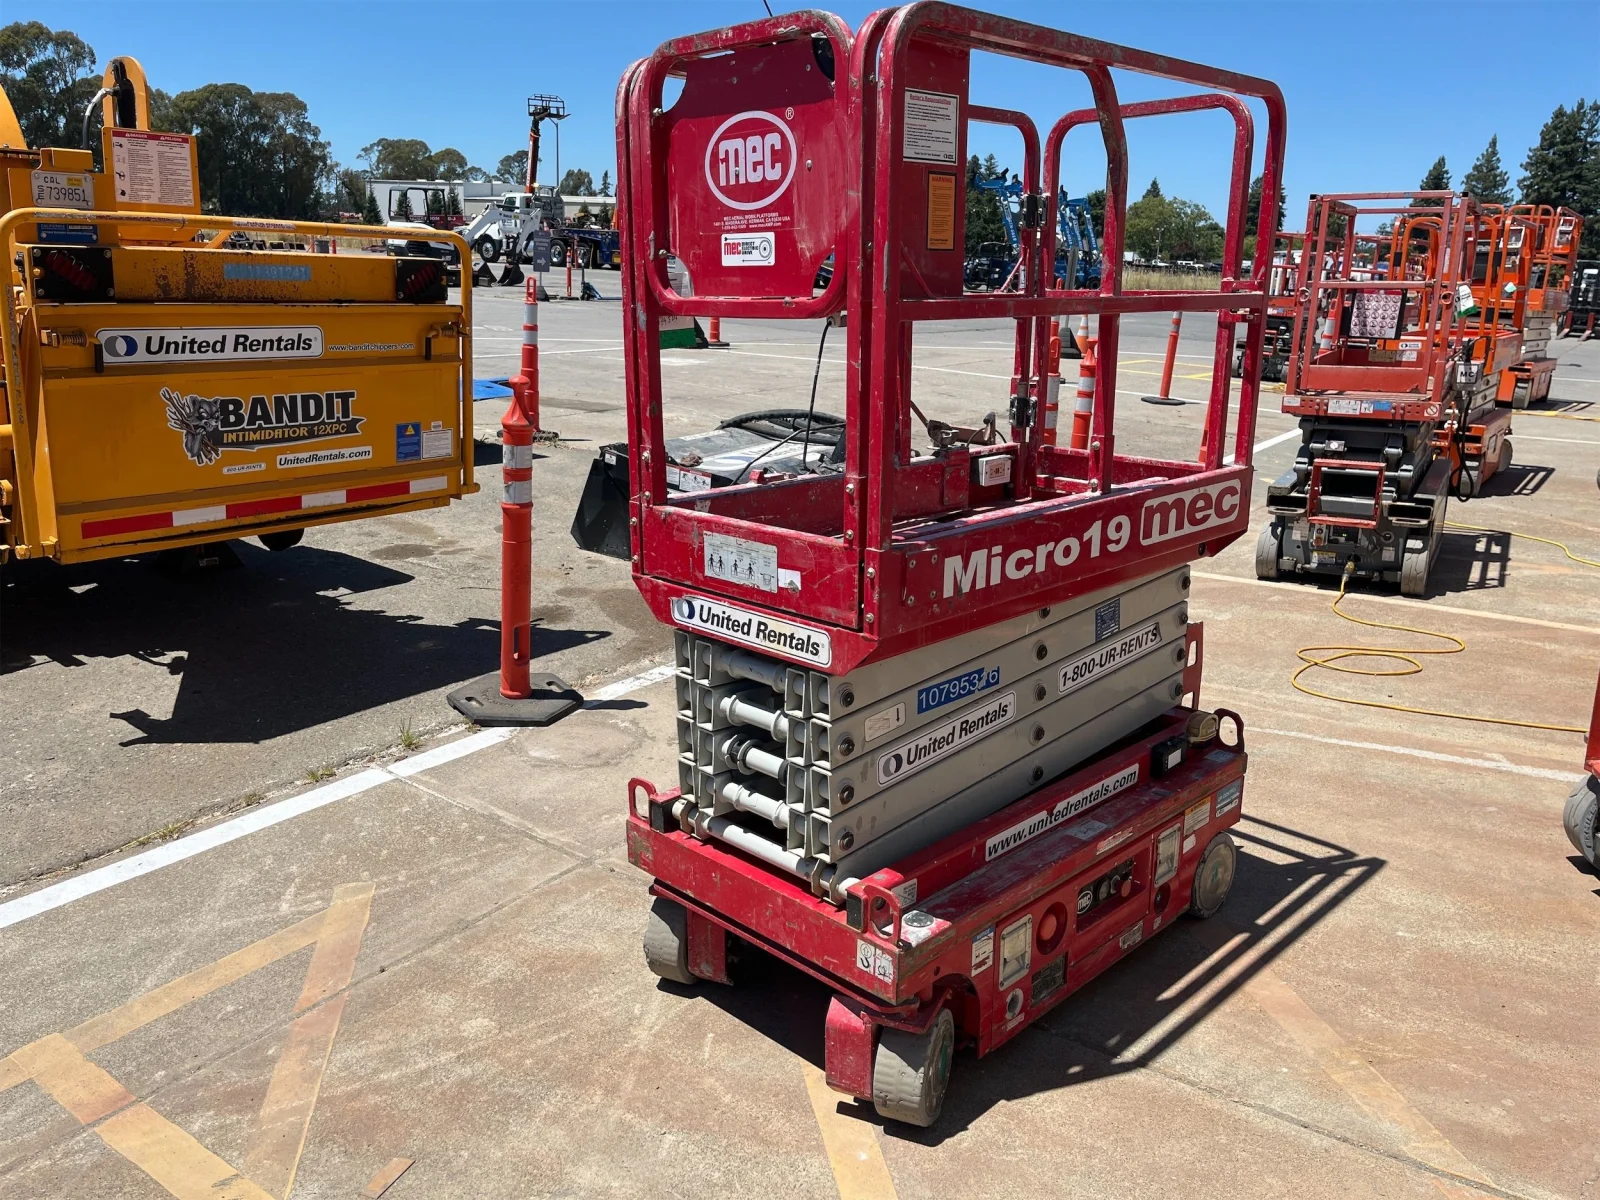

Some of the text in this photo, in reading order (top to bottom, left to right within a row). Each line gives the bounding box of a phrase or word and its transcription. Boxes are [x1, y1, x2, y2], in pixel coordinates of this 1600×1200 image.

[43, 176, 60, 184] CAL
[46, 186, 89, 201] 739851
[145, 333, 313, 355] United Rentals
[329, 343, 415, 351] www.banditchippers.com
[220, 391, 356, 429] BANDIT
[223, 423, 347, 443] INTIMIDATOR 12XPC
[278, 450, 371, 467] UnitedRentals.com
[943, 515, 1131, 599] Micro19
[699, 604, 820, 657] United Rentals
[1061, 626, 1157, 687] 1-800-UR-RENTS
[906, 702, 1008, 766] United Rentals
[987, 770, 1136, 857] www.unitedrentals.com
